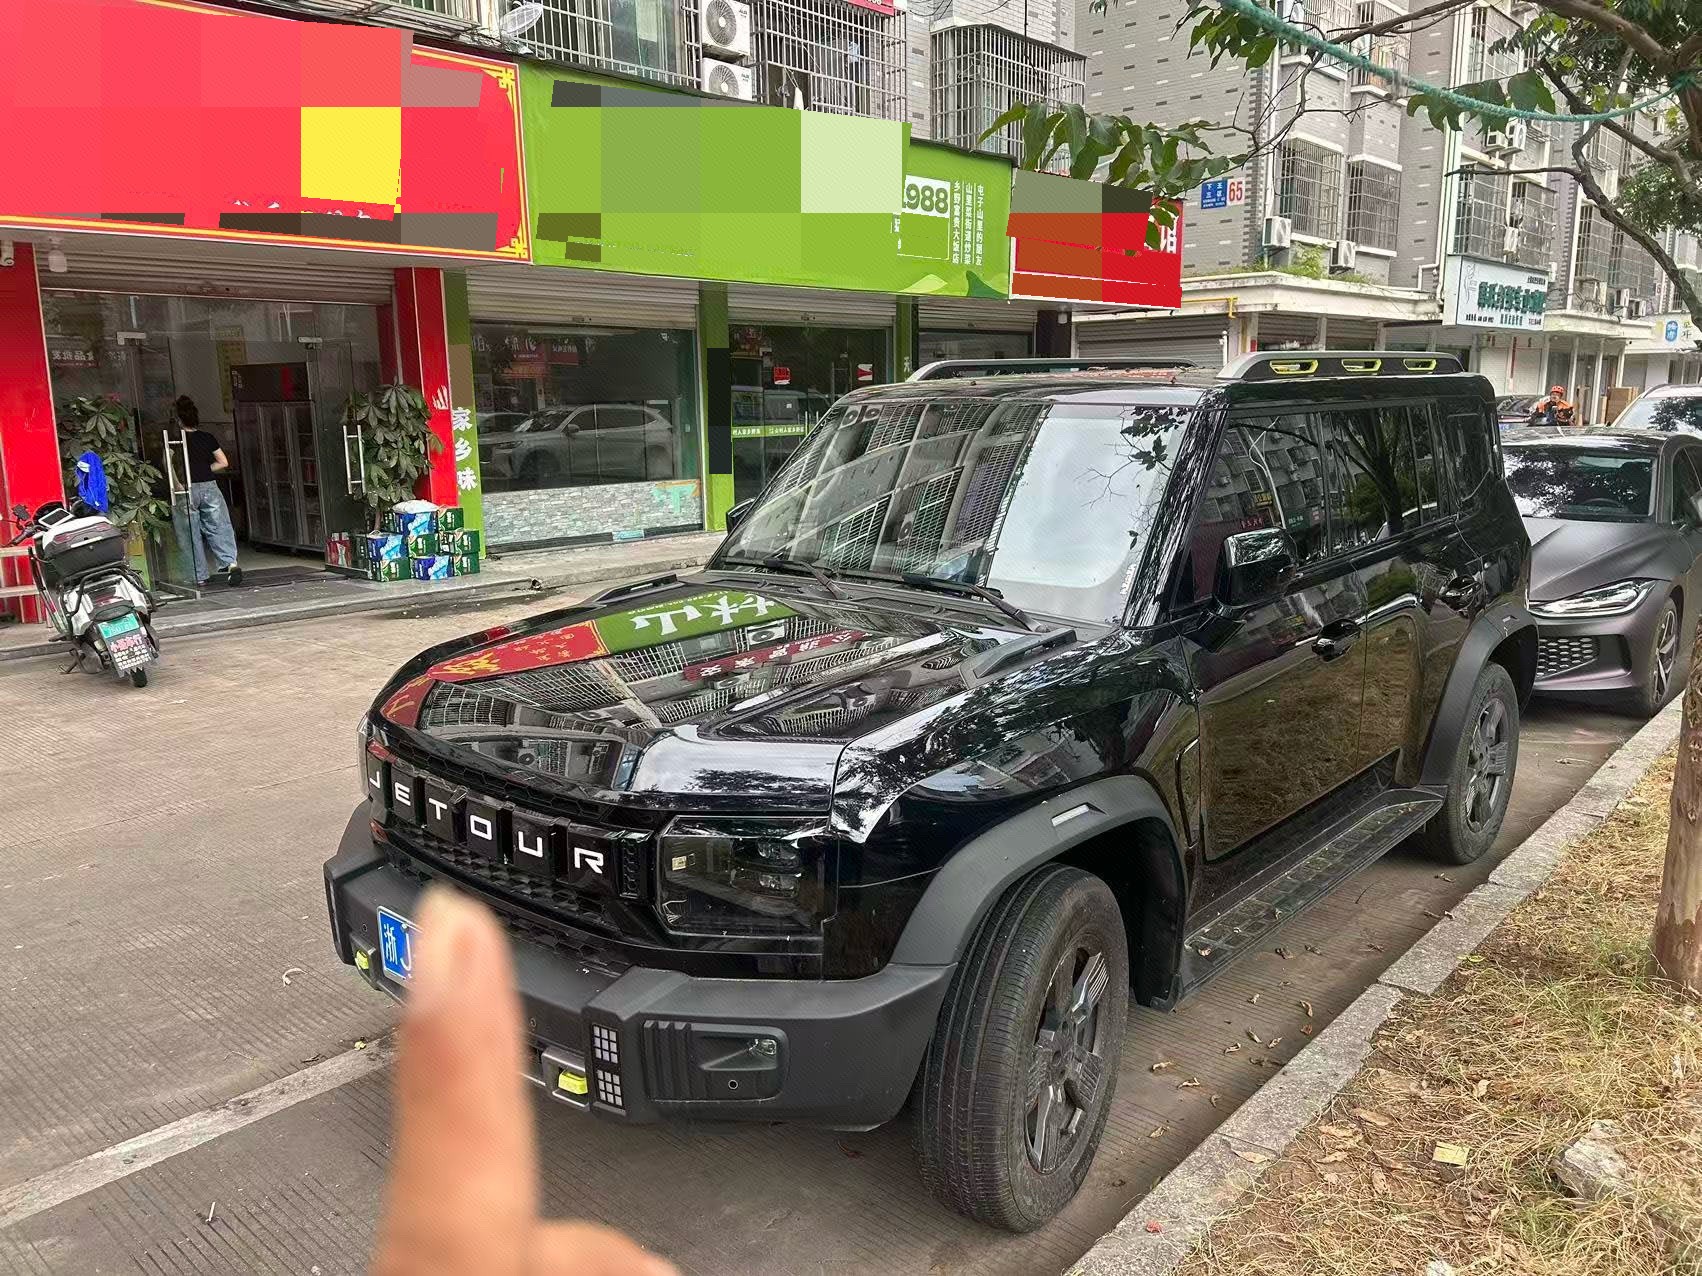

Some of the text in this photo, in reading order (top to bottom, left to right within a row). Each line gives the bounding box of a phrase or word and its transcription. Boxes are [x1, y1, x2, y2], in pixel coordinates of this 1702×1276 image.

[903, 183, 948, 214] 988
[1229, 181, 1243, 202] 65
[452, 406, 478, 491] 家乡味
[368, 771, 605, 874] JETOUR
